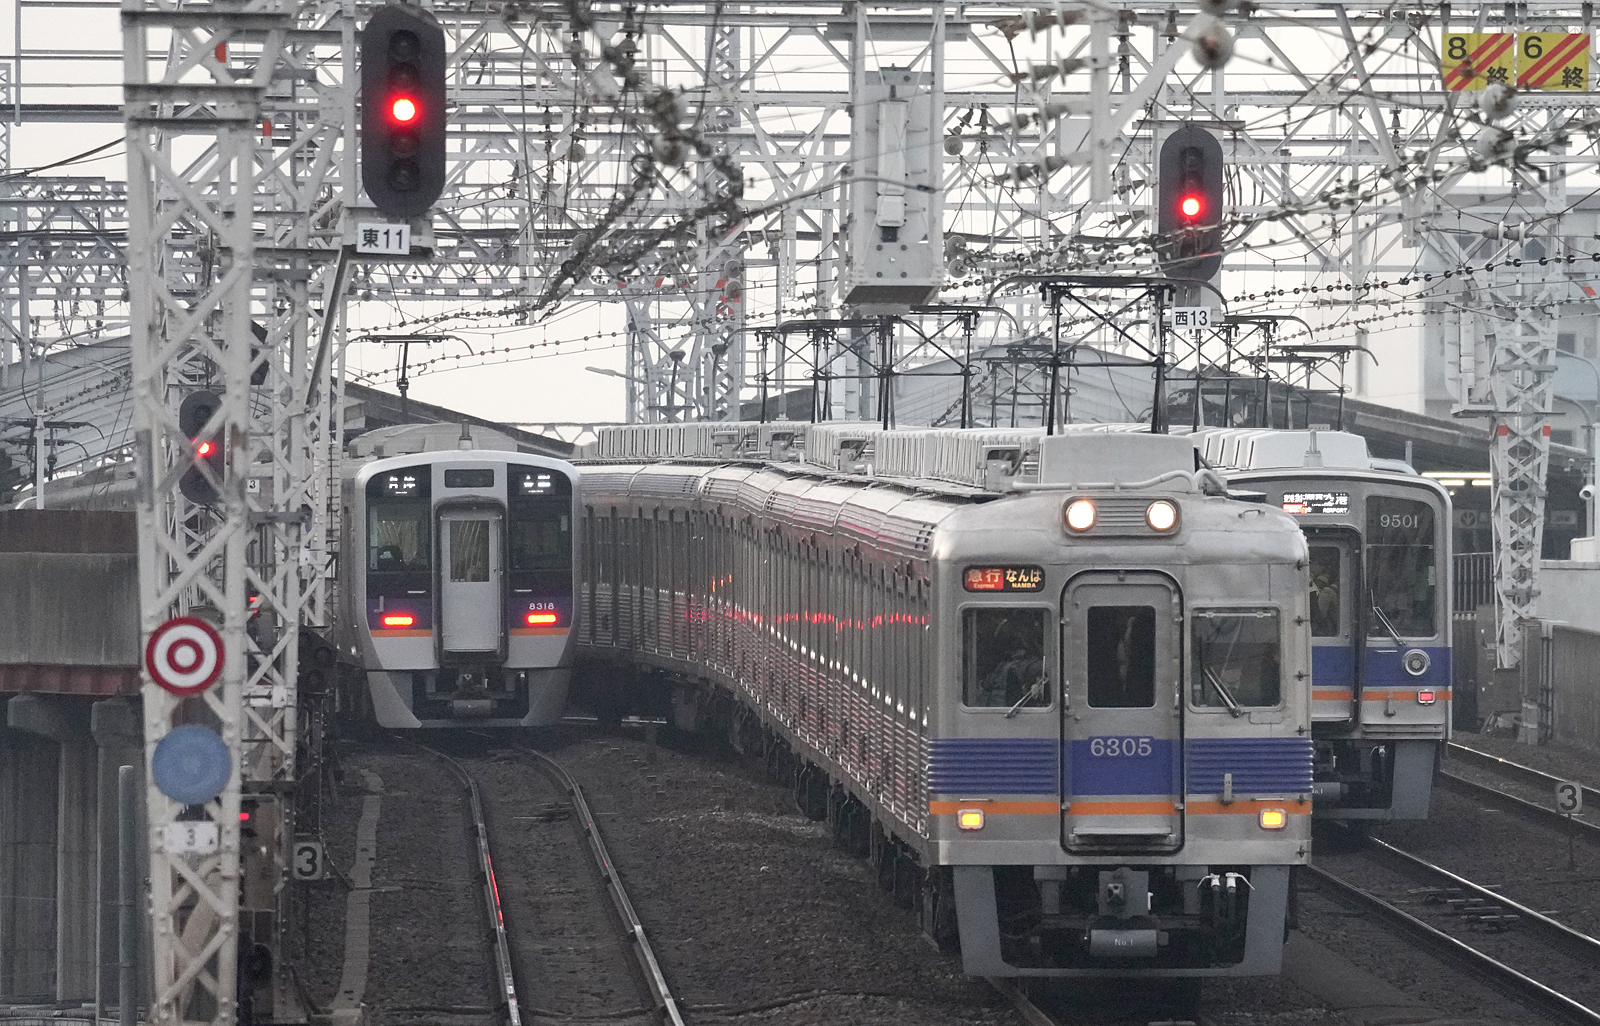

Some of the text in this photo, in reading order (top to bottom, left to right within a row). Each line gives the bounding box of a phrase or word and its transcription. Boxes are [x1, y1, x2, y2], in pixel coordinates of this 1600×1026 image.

[1447, 36, 1467, 60] 8
[1523, 36, 1543, 59] 6
[1561, 66, 1584, 88] 終
[362, 228, 403, 250] 東11
[1175, 310, 1208, 326] 西13
[249, 479, 256, 489] 3
[1380, 514, 1419, 528] 9501
[529, 602, 555, 610] 8318
[1090, 738, 1152, 756] 6305
[1559, 784, 1577, 810] 3
[297, 846, 318, 877] 3
